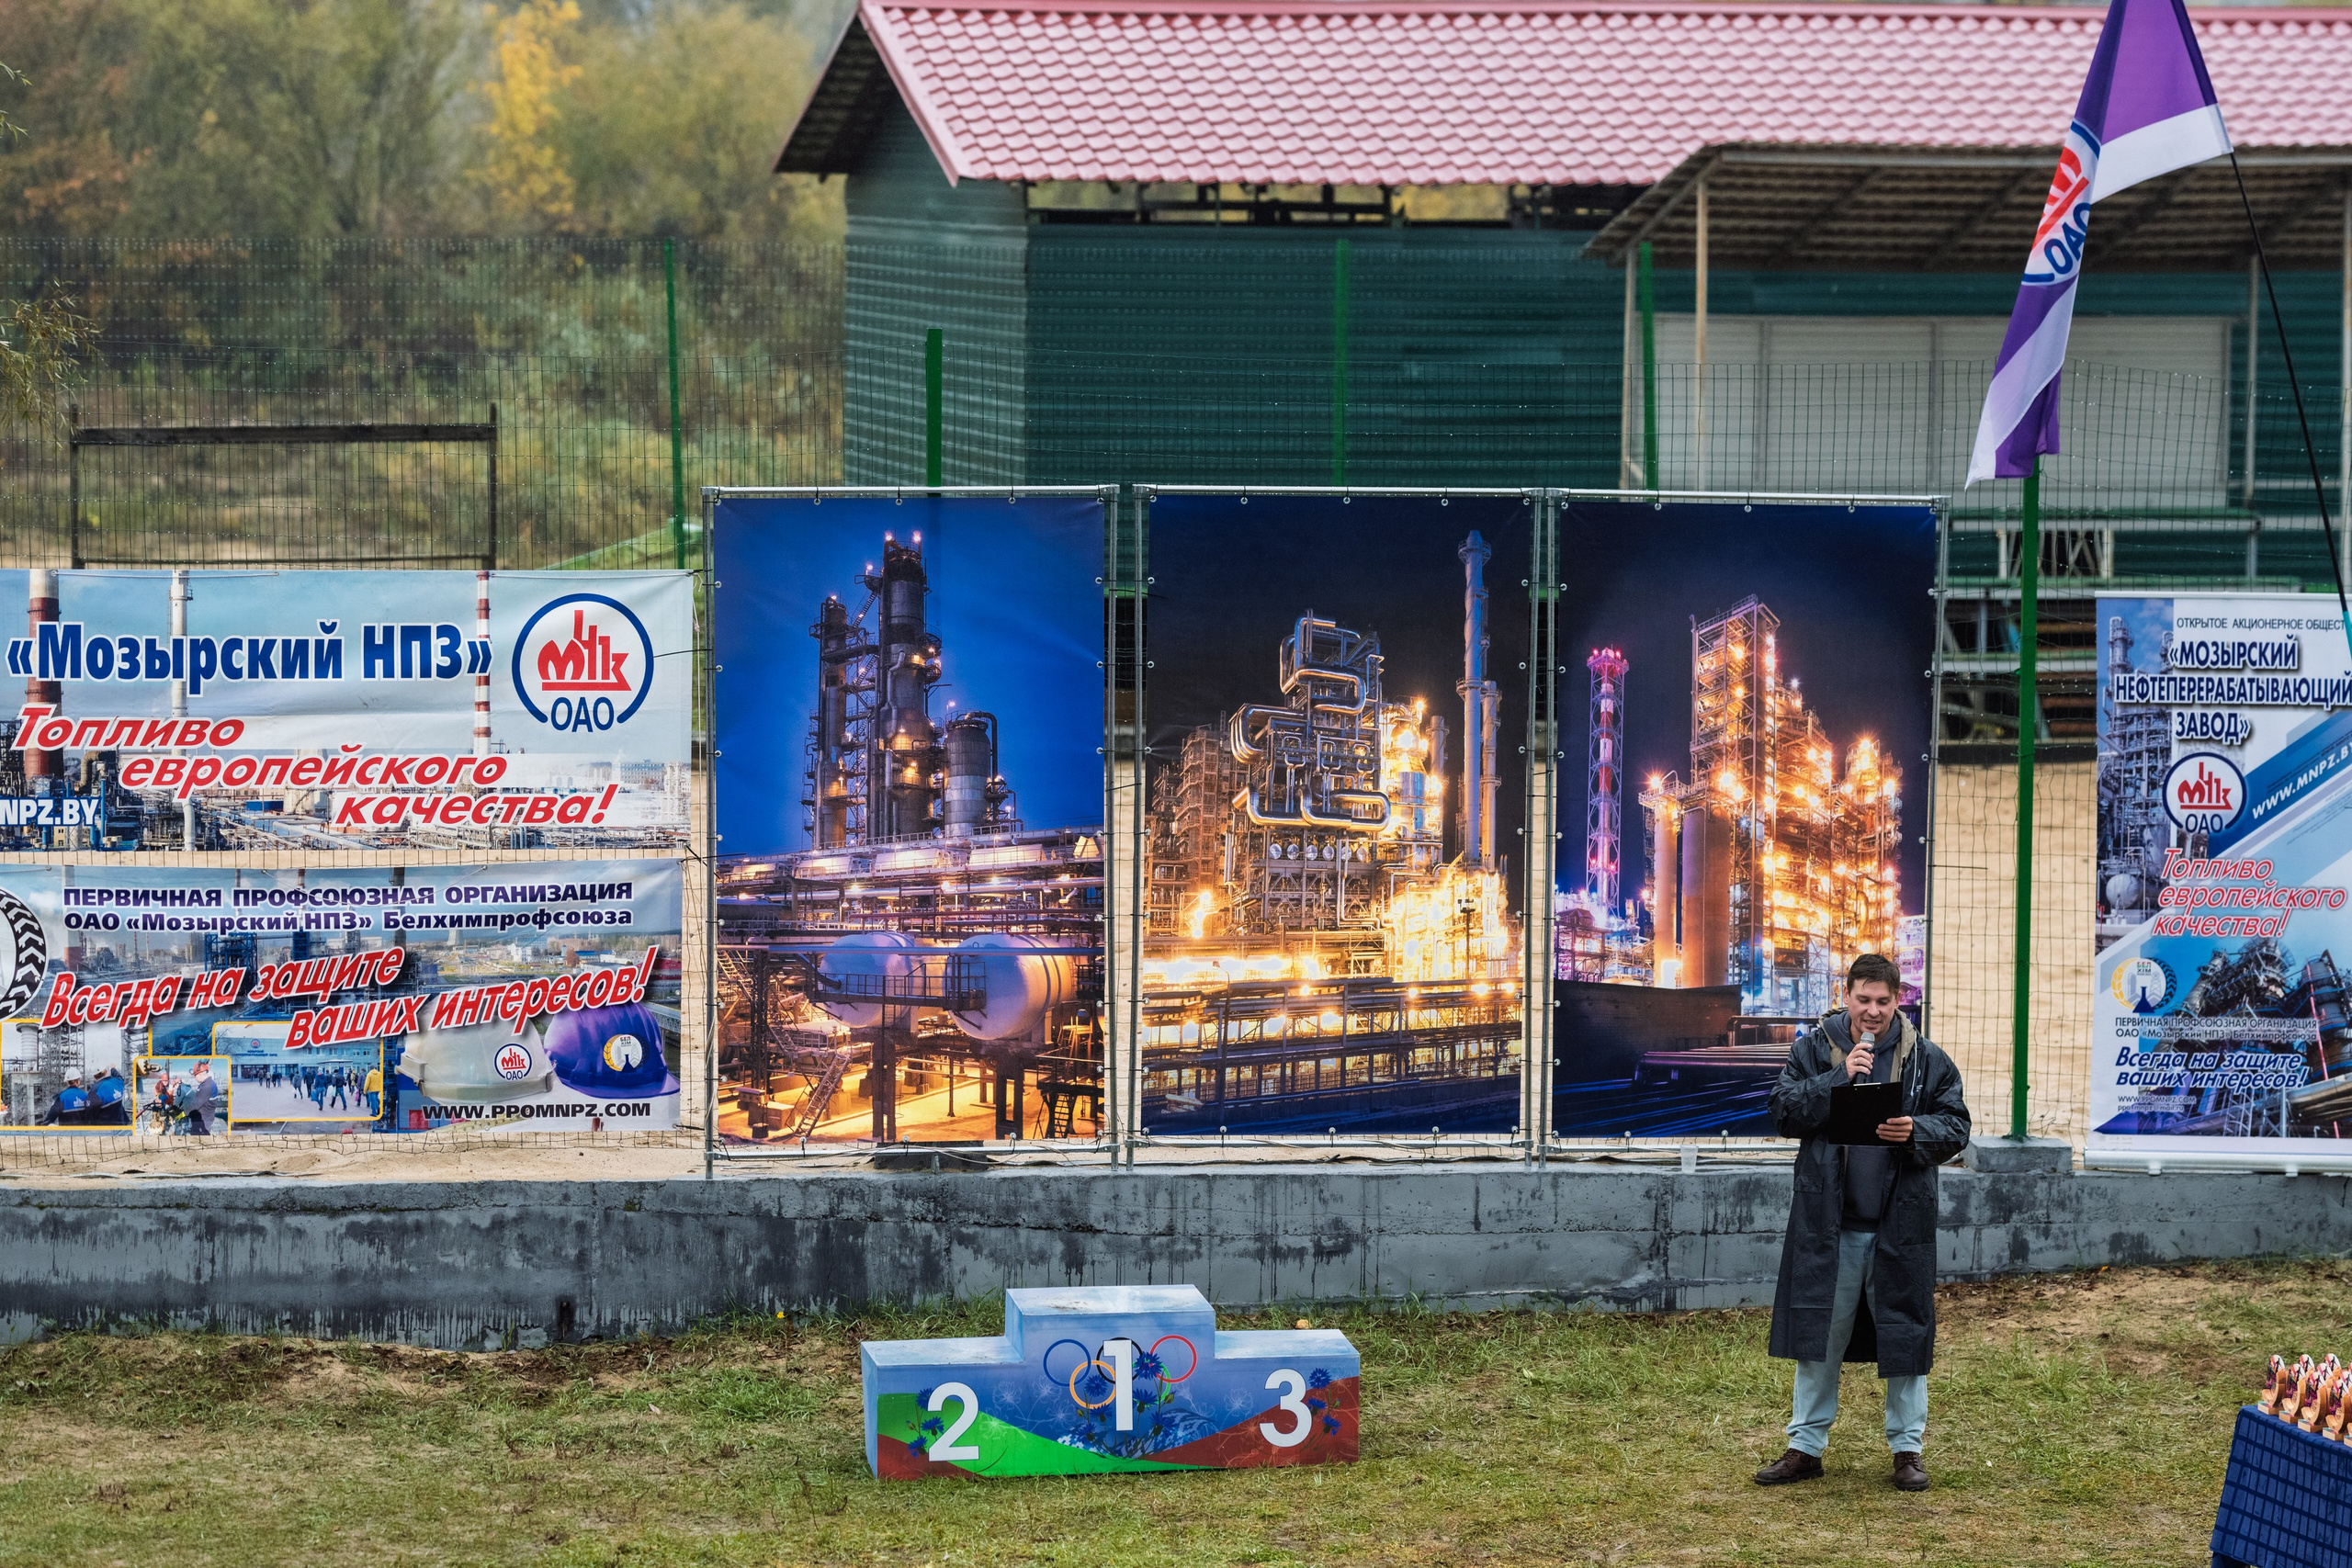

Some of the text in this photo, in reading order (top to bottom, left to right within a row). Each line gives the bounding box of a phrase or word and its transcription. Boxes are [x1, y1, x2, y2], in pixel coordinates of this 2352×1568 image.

[2177, 618, 2346, 632] ОТКРЫТОЕ АКЦИОНЕРНОЕ ОБЩЕСТ
[8, 619, 492, 694] «Мозырский НПЗ»
[2169, 634, 2296, 668] «МОЗЫРСКИЙ
[2116, 671, 2352, 709] НЕФТЕПЕРЕРАБАТЫВАЮЩИЙ
[11, 707, 244, 749] Топливо
[551, 696, 615, 732] ОАО
[2175, 711, 2248, 744] ЗАВОД»
[119, 744, 507, 797] европейского
[336, 785, 617, 824] качества!
[2186, 813, 2223, 834] ОАО
[2161, 848, 2273, 879] Топливо
[63, 883, 632, 908] ПЕРВИЧНАЯ ПРОФСОЮЗНАЯ ОРГАНИЗАЦИЯ
[2158, 882, 2346, 915] европейского
[64, 908, 632, 934] ОАО «Мозырский НПЗ» Белхимпрофсоюза
[2153, 909, 2290, 936] качества!
[42, 946, 404, 1028] Всегда на защите
[286, 944, 658, 1048] ваших интересов!
[2115, 1018, 2316, 1029] ПЕРВИЧНАЯ ПРОФСОЮЗНАЯ ОРГАНИЗАЦИЯ
[2116, 1029, 2139, 1037] ОАО
[2143, 1030, 2201, 1040] «Мозырский
[2205, 1030, 2231, 1039] НПЗ»
[2115, 1046, 2301, 1069] Всегда на защите
[506, 1071, 523, 1080] ОАО
[2116, 1067, 2308, 1093] ваших интересов!
[424, 1103, 650, 1119] WWW.PPOMNPZ.COM
[1103, 1340, 1133, 1431] 1
[928, 1382, 979, 1461] 2
[1260, 1369, 1312, 1448] 3
